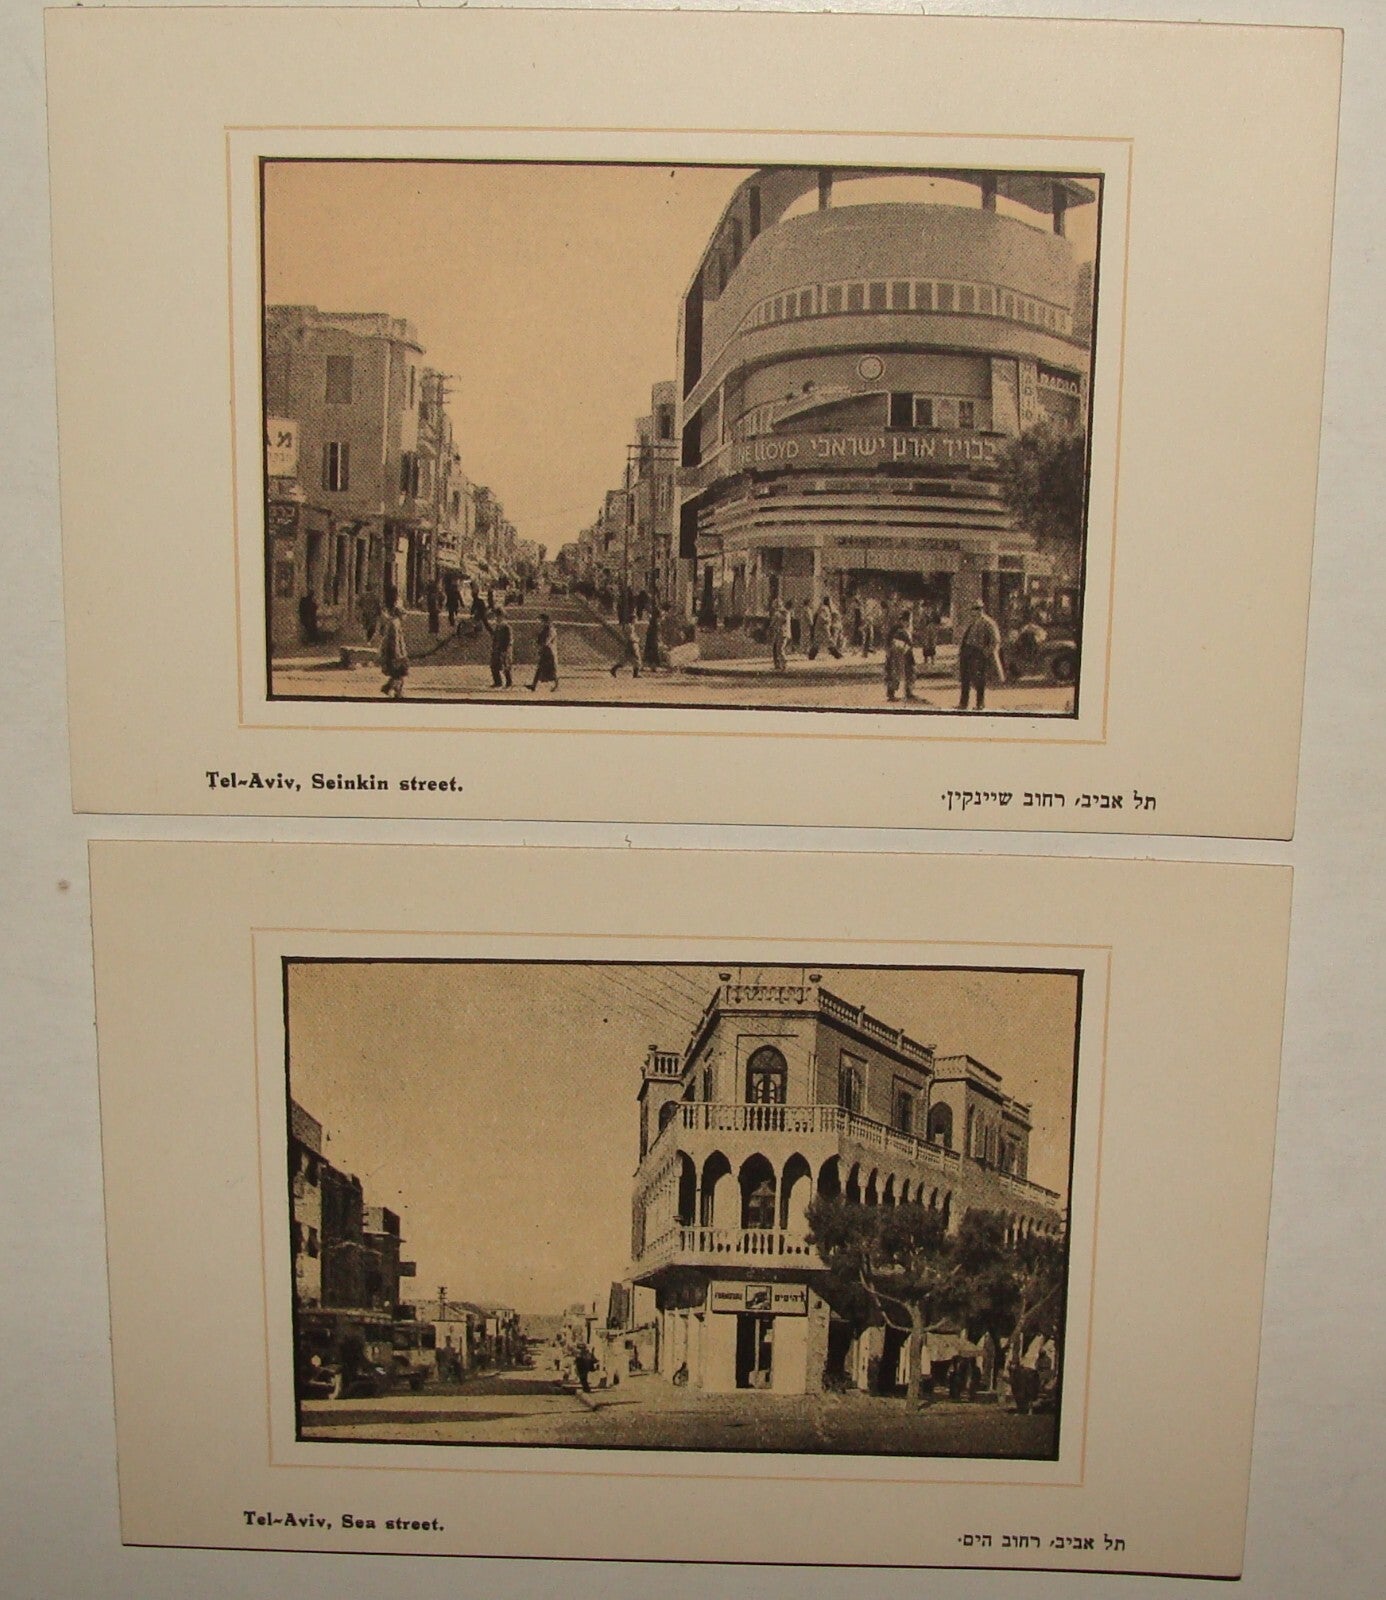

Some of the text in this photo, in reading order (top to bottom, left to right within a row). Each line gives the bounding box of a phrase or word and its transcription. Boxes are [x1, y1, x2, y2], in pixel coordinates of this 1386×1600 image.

[754, 440, 799, 461] LLOYD
[312, 773, 388, 791] Seinkin
[399, 776, 463, 793] street.
[1023, 791, 1066, 808] רחוב
[1133, 789, 1157, 811] תל
[342, 1514, 376, 1530] Sea
[385, 1516, 444, 1532] street.
[1002, 1534, 1041, 1549] רחוב
[1103, 1533, 1126, 1552] תל
